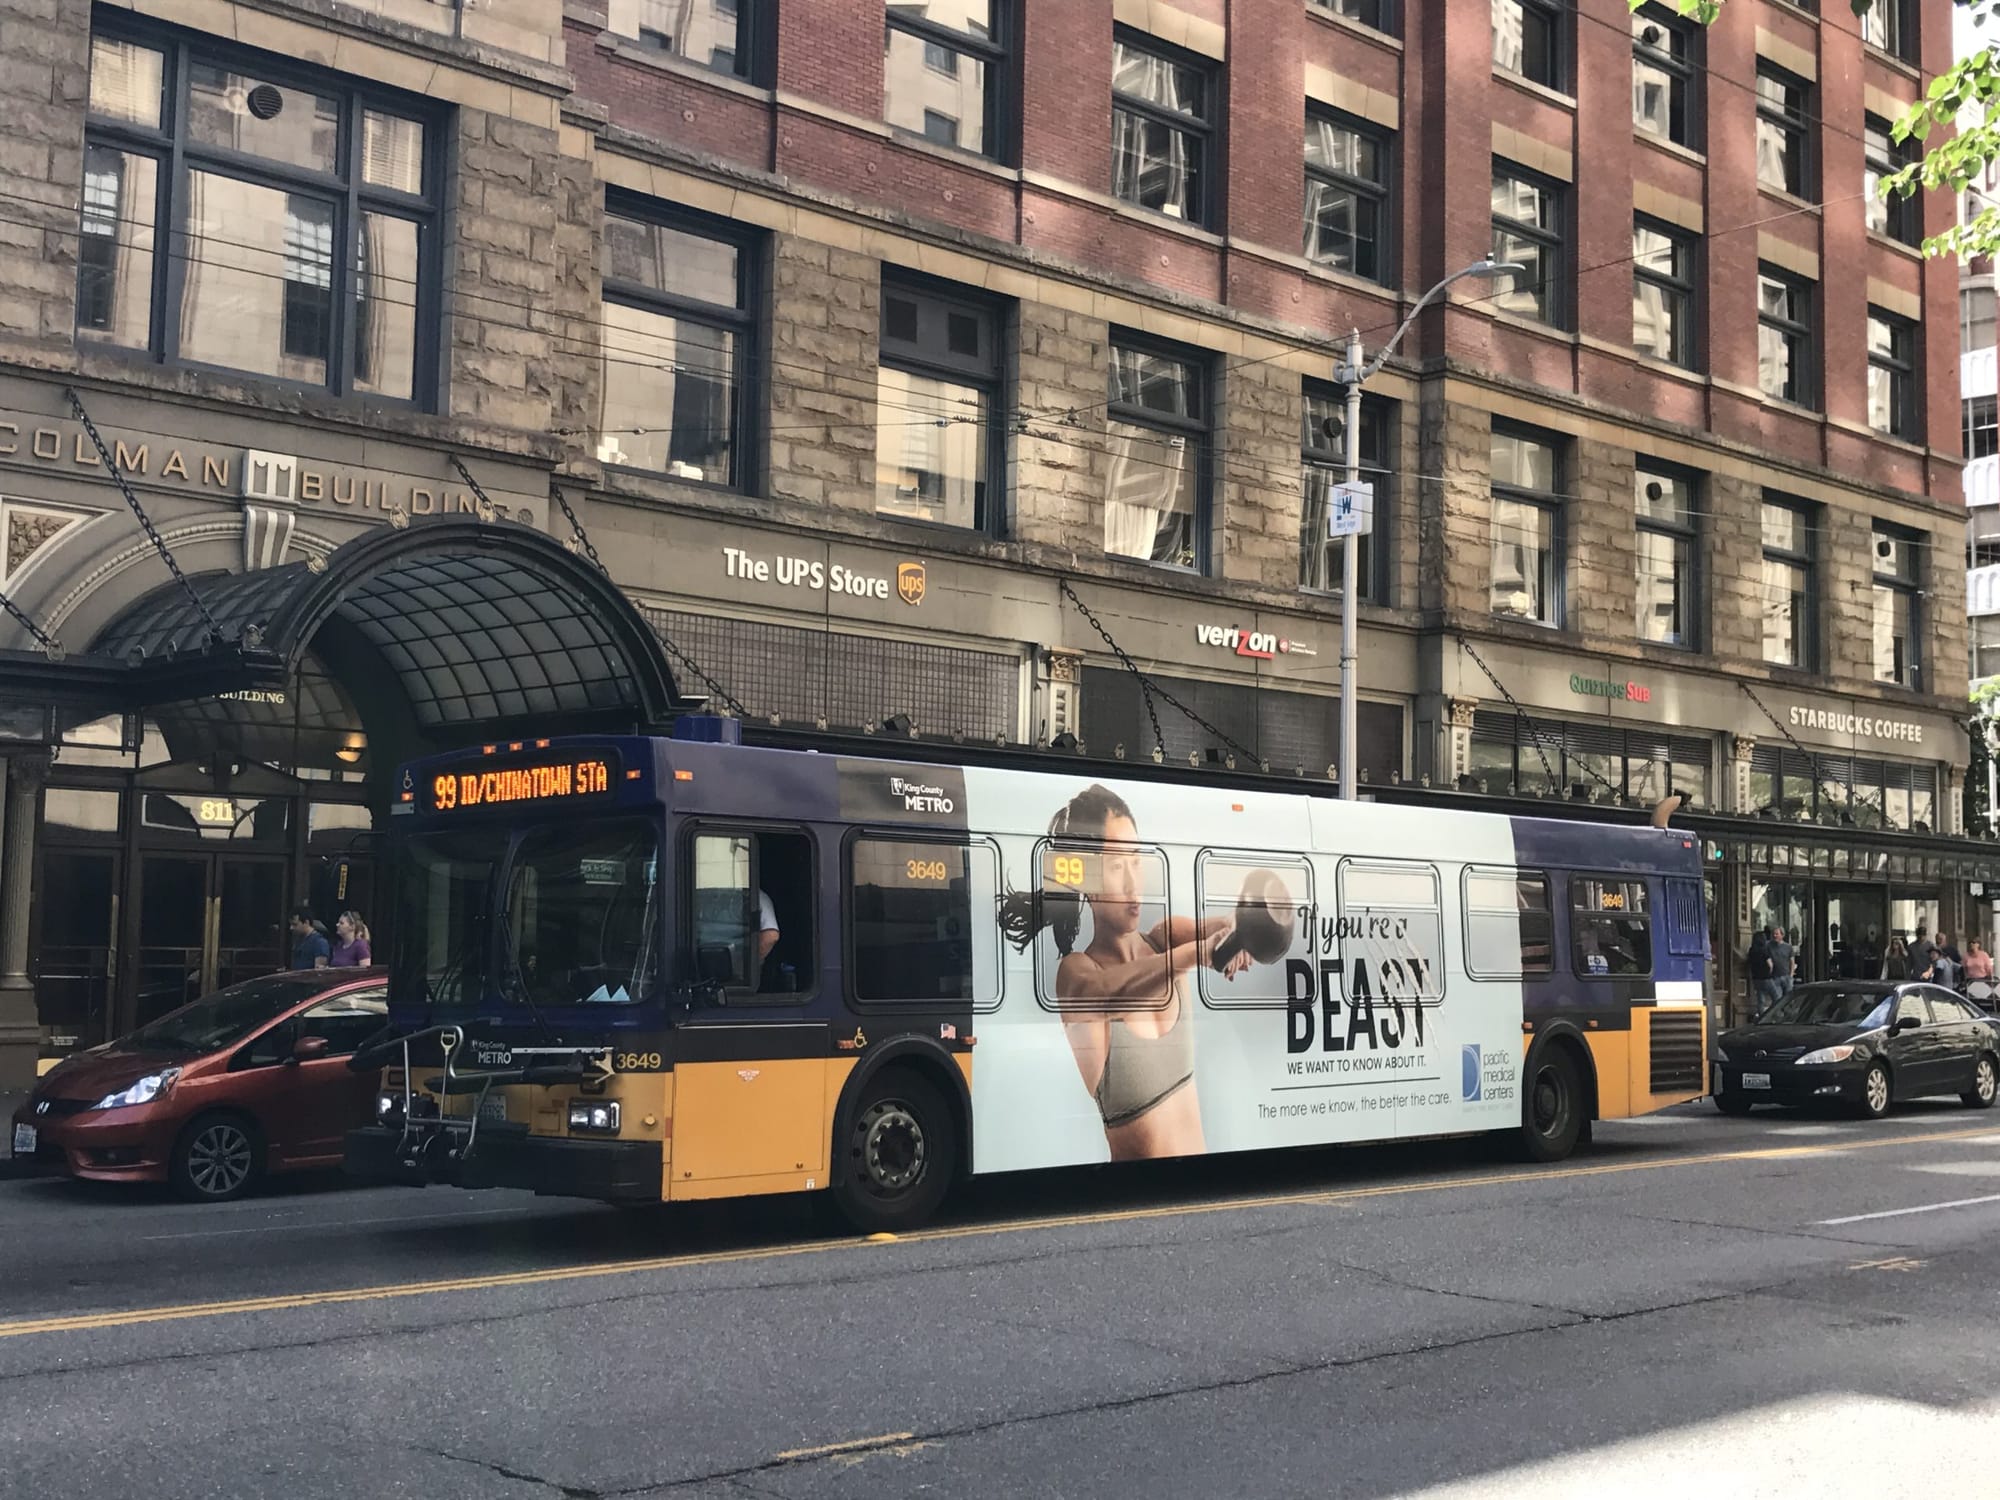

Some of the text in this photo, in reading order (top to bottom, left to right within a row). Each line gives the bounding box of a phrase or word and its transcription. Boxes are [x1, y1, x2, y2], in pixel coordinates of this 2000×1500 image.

[0, 422, 229, 487] COLMAN
[723, 547, 888, 599] The UPS Store
[901, 575, 923, 598] ups
[1197, 623, 1277, 659] verizon
[1790, 706, 1922, 743] STARBUCKS COFFEE
[434, 761, 608, 810] 99 ID/CHINATOWN STA
[904, 783, 944, 797] King County
[200, 801, 234, 821] 811
[905, 795, 954, 813] METRO
[906, 859, 946, 881] 3649
[1054, 856, 1084, 885] 99
[1602, 893, 1624, 908] 3649
[1297, 902, 1408, 955] If you're a
[1286, 957, 1430, 1054] BEAST
[478, 1051, 512, 1065] METRO
[616, 1052, 662, 1070] 3649
[1287, 1055, 1426, 1075] WE WANT TO KNOW ABOUT IT.
[1483, 1049, 1509, 1069] pacific
[1483, 1066, 1515, 1083] medical
[1483, 1085, 1514, 1101] centers
[1258, 1091, 1452, 1119] The more we know, the better the care.
